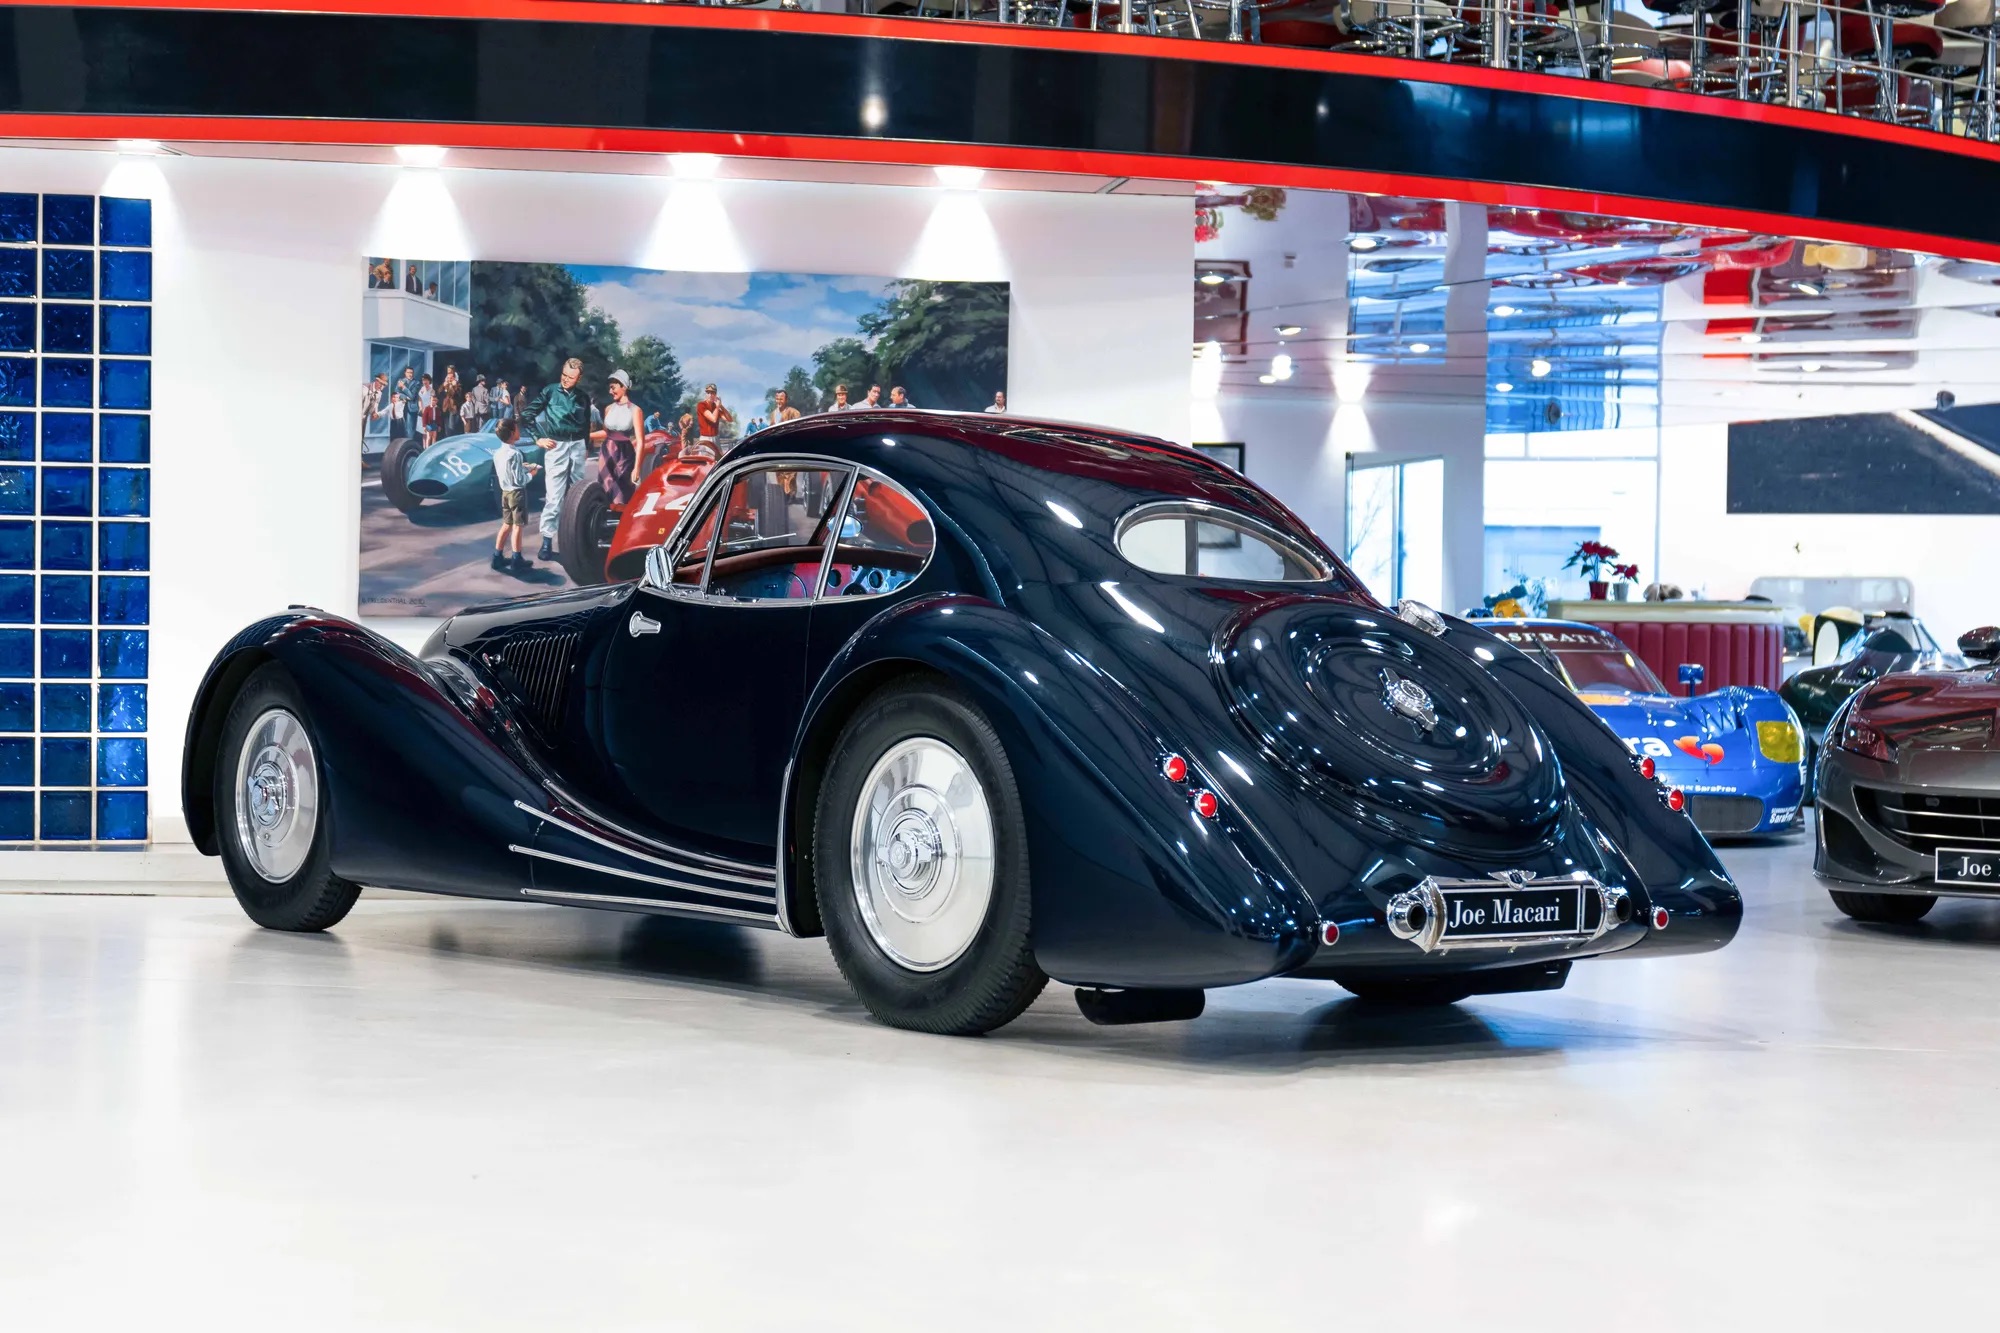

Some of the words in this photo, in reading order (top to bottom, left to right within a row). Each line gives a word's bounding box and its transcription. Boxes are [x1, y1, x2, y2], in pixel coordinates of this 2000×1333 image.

[440, 454, 473, 478] 18
[1957, 856, 1992, 877] Joe
[1449, 899, 1486, 929] Joe
[1491, 897, 1561, 924] Macari
